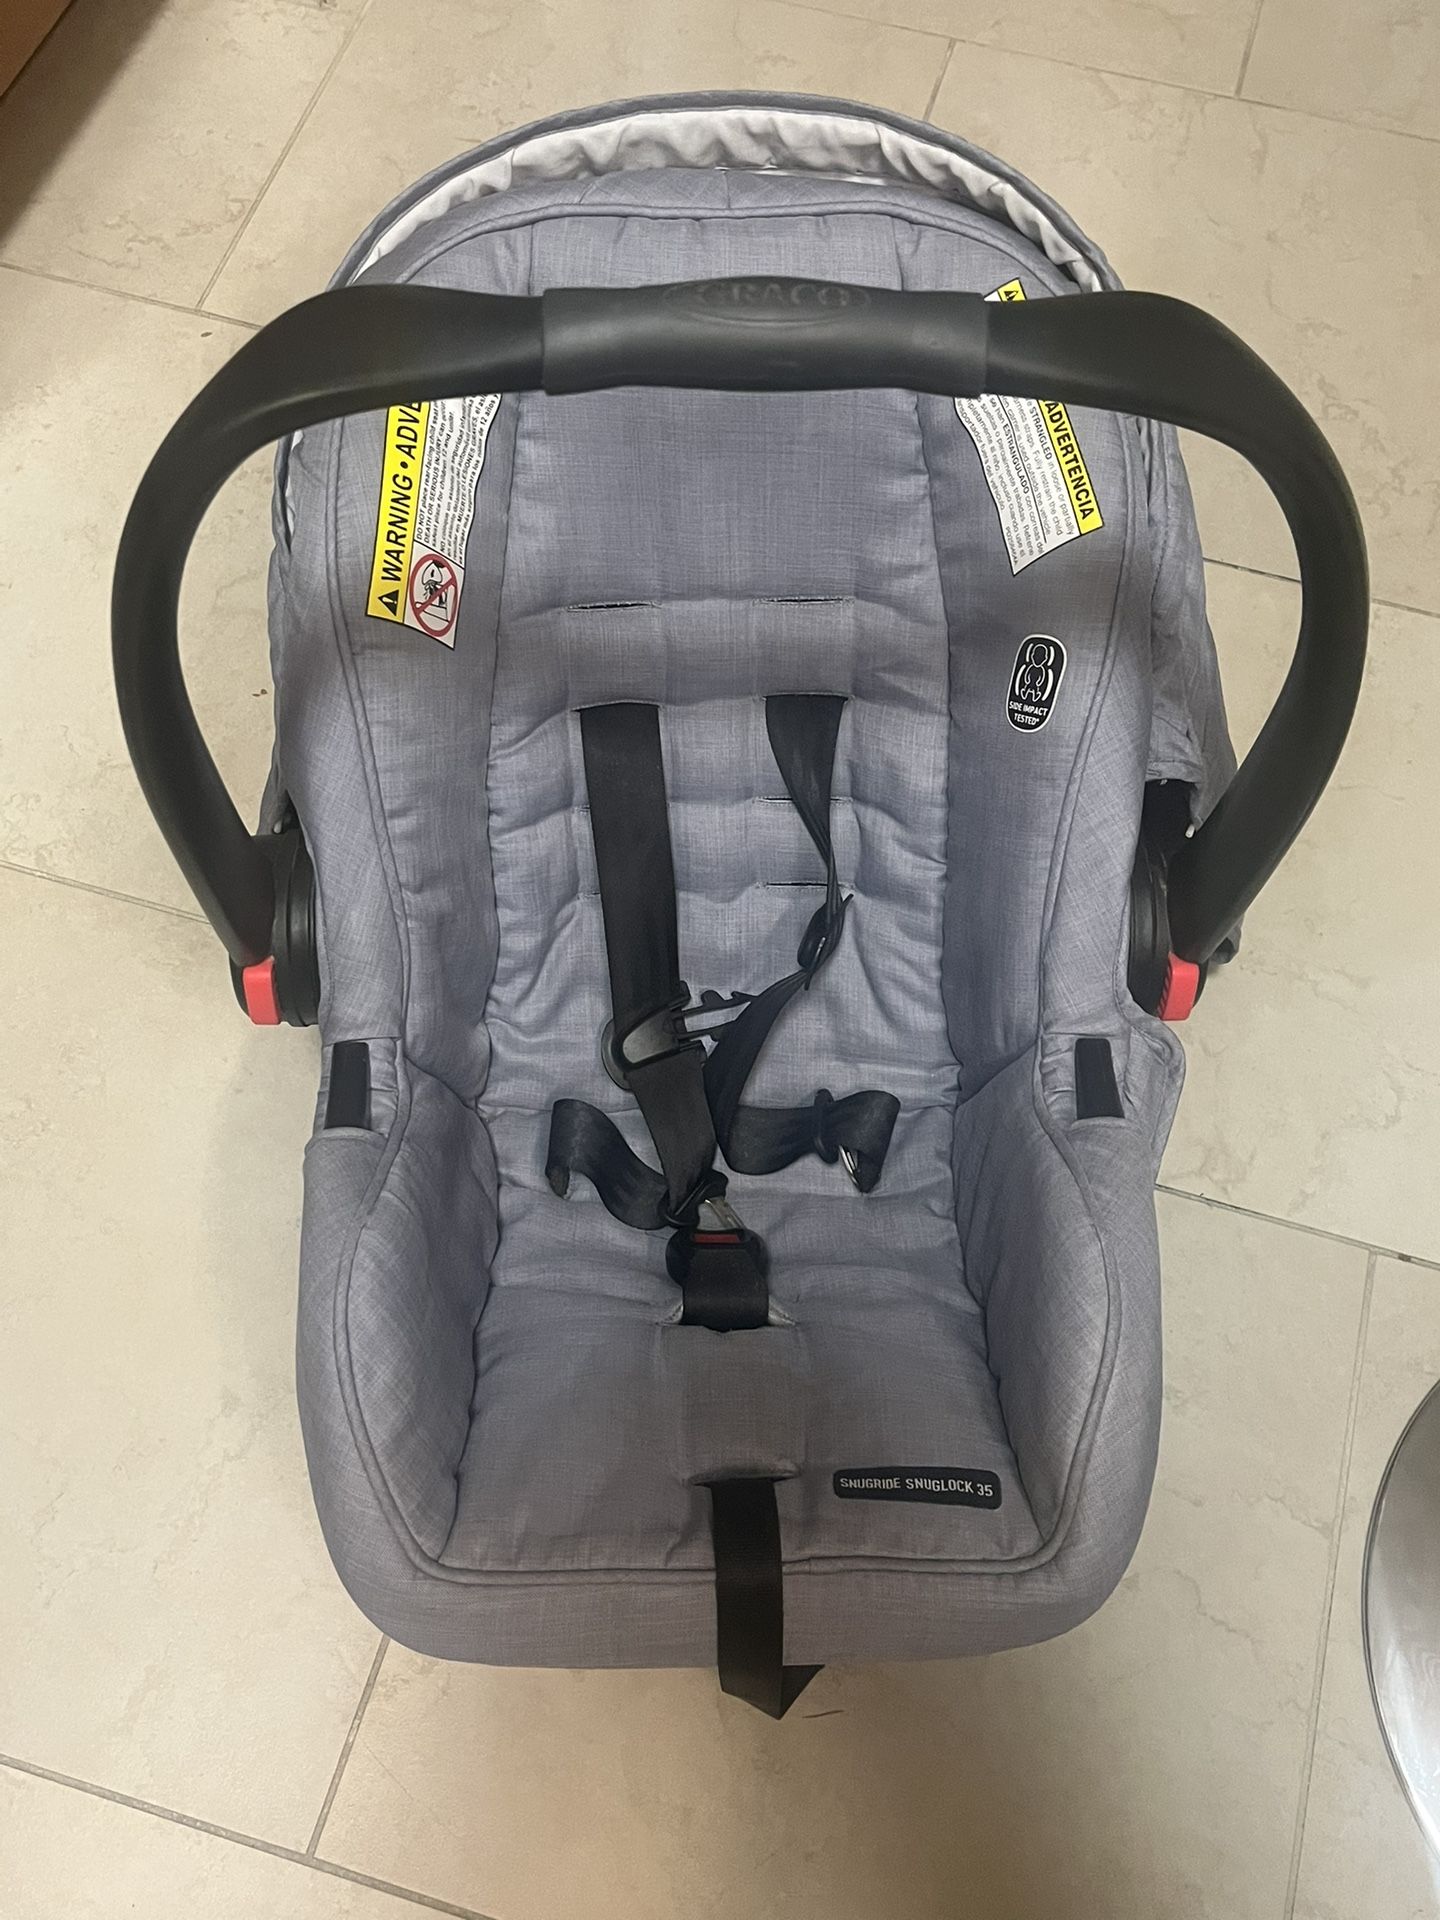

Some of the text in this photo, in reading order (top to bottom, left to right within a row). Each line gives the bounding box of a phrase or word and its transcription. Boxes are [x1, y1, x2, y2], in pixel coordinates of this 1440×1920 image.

[480, 416, 487, 425] 12
[485, 399, 496, 417] años
[442, 449, 447, 457] 12
[461, 447, 475, 484] LESIONES
[1002, 423, 1031, 494] ESTRANGULADO
[1025, 495, 1034, 511] con
[1045, 402, 1095, 520] ADVERTENCIA
[430, 466, 439, 502] SERIOUS
[1029, 407, 1053, 460] STRANGLED
[1059, 504, 1076, 535] partially
[1039, 471, 1053, 501] restrain
[417, 527, 423, 540] DO
[425, 445, 435, 486] rear-facing
[440, 541, 445, 552] NO
[451, 429, 464, 464] seguridad
[428, 503, 434, 516] OR
[458, 492, 466, 523] MUERTE
[1049, 501, 1057, 514] the
[381, 473, 414, 583] WARNING
[1052, 516, 1064, 536] child
[1009, 701, 1048, 716] SIDE IMPACT
[840, 1477, 994, 1498] SNUGRIDE SNUGLOCK 35
